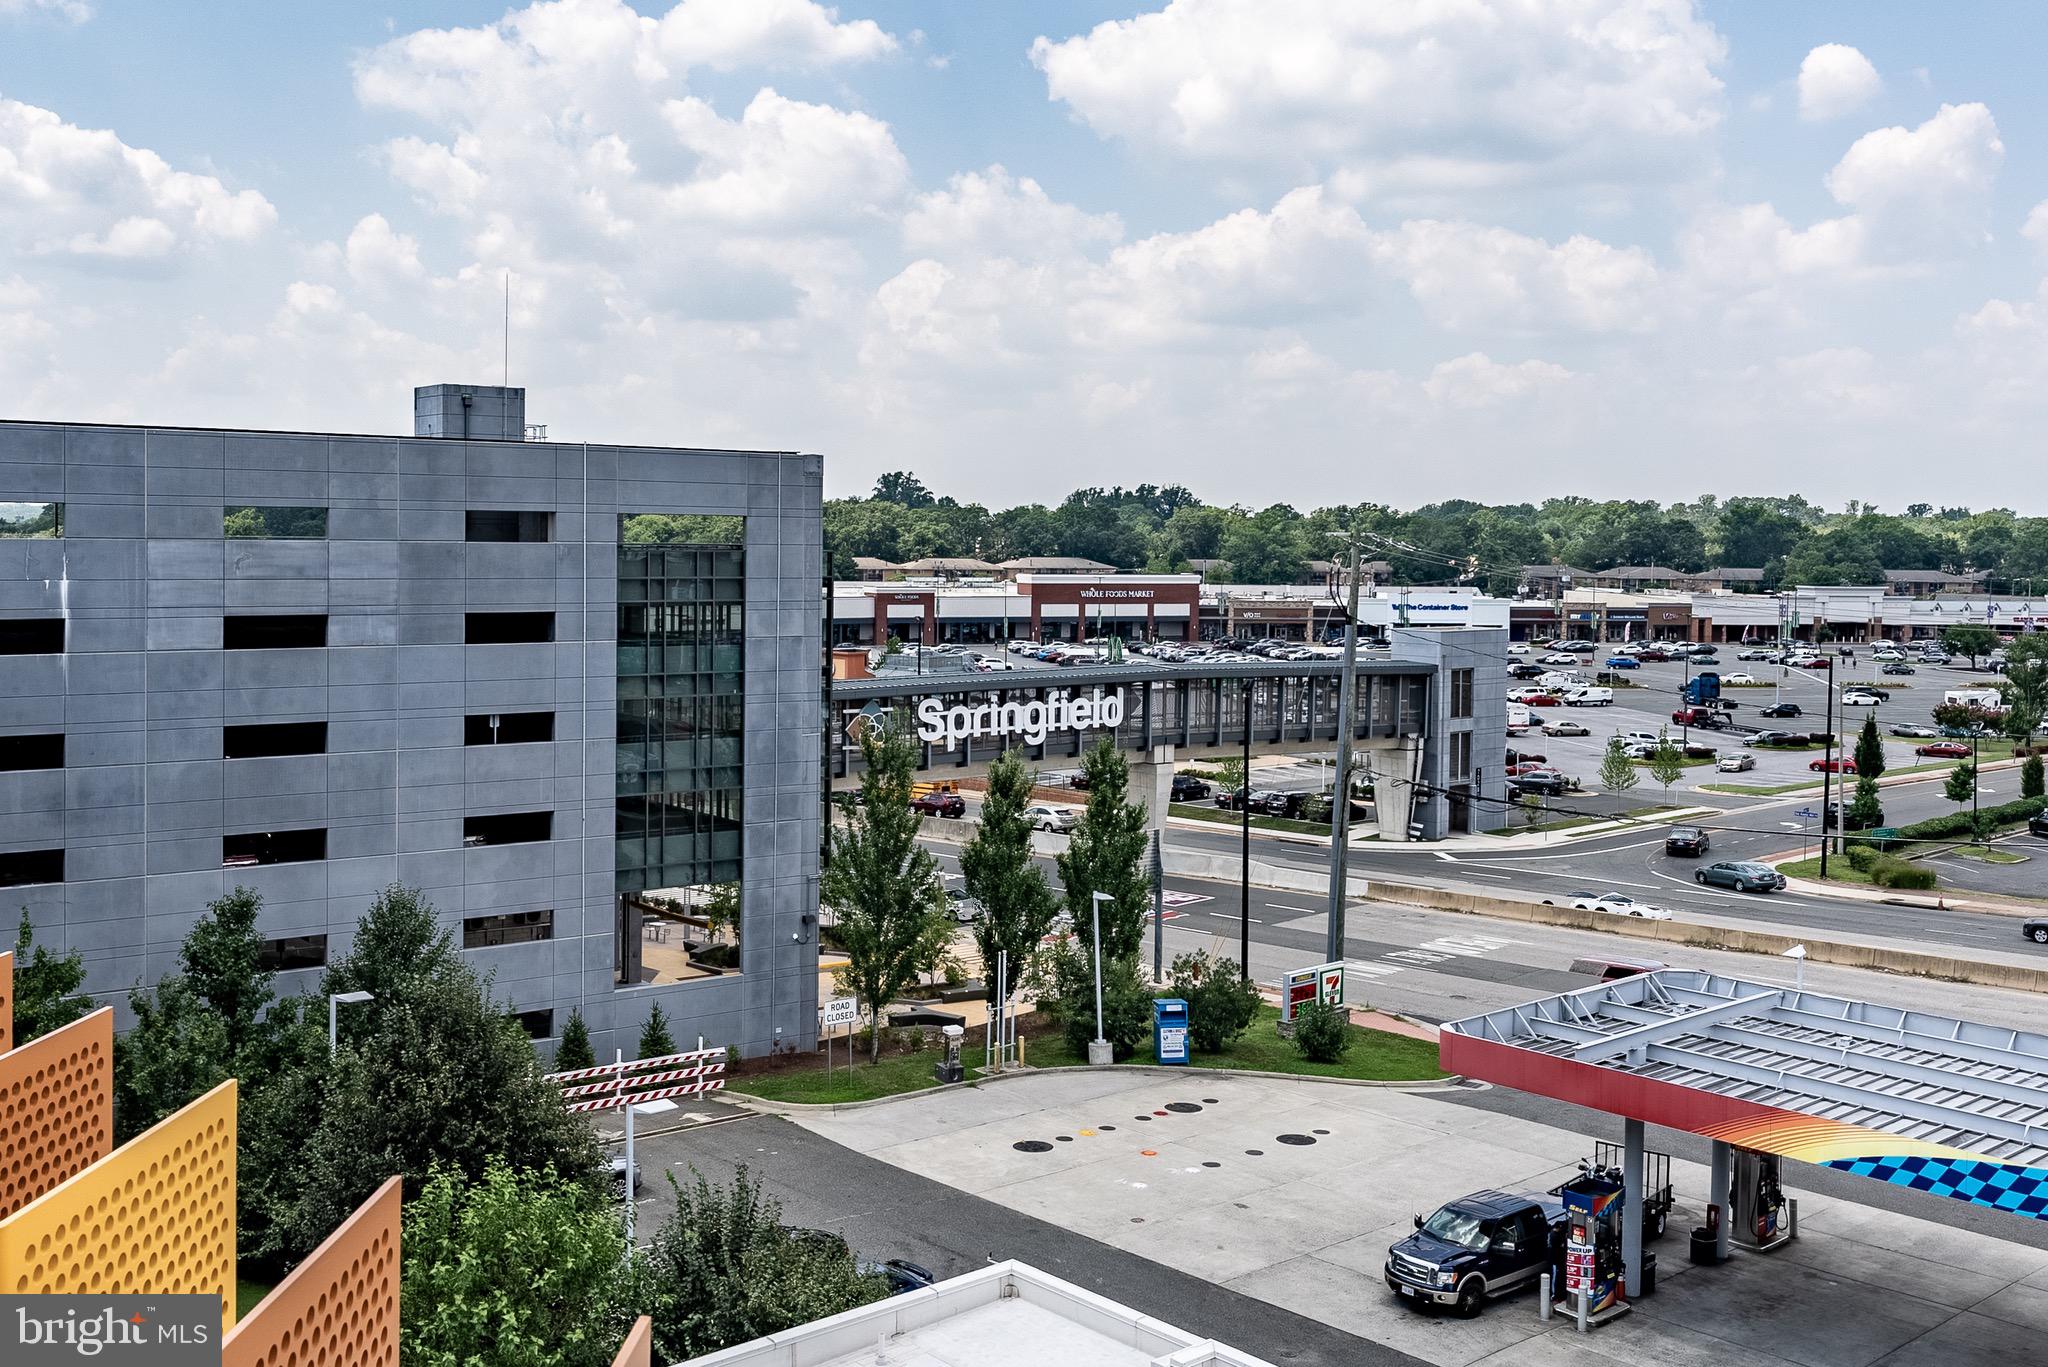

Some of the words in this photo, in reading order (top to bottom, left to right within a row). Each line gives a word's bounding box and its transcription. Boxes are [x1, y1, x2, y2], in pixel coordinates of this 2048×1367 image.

[1080, 588, 1104, 598] WHOLE
[1105, 590, 1127, 598] FOODS
[1128, 590, 1155, 598] MARKET
[1417, 603, 1450, 611] Container
[1450, 603, 1469, 611] Store
[917, 687, 1124, 751] Springfield
[830, 1001, 850, 1011] ROAD
[826, 1011, 854, 1022] CLOSED
